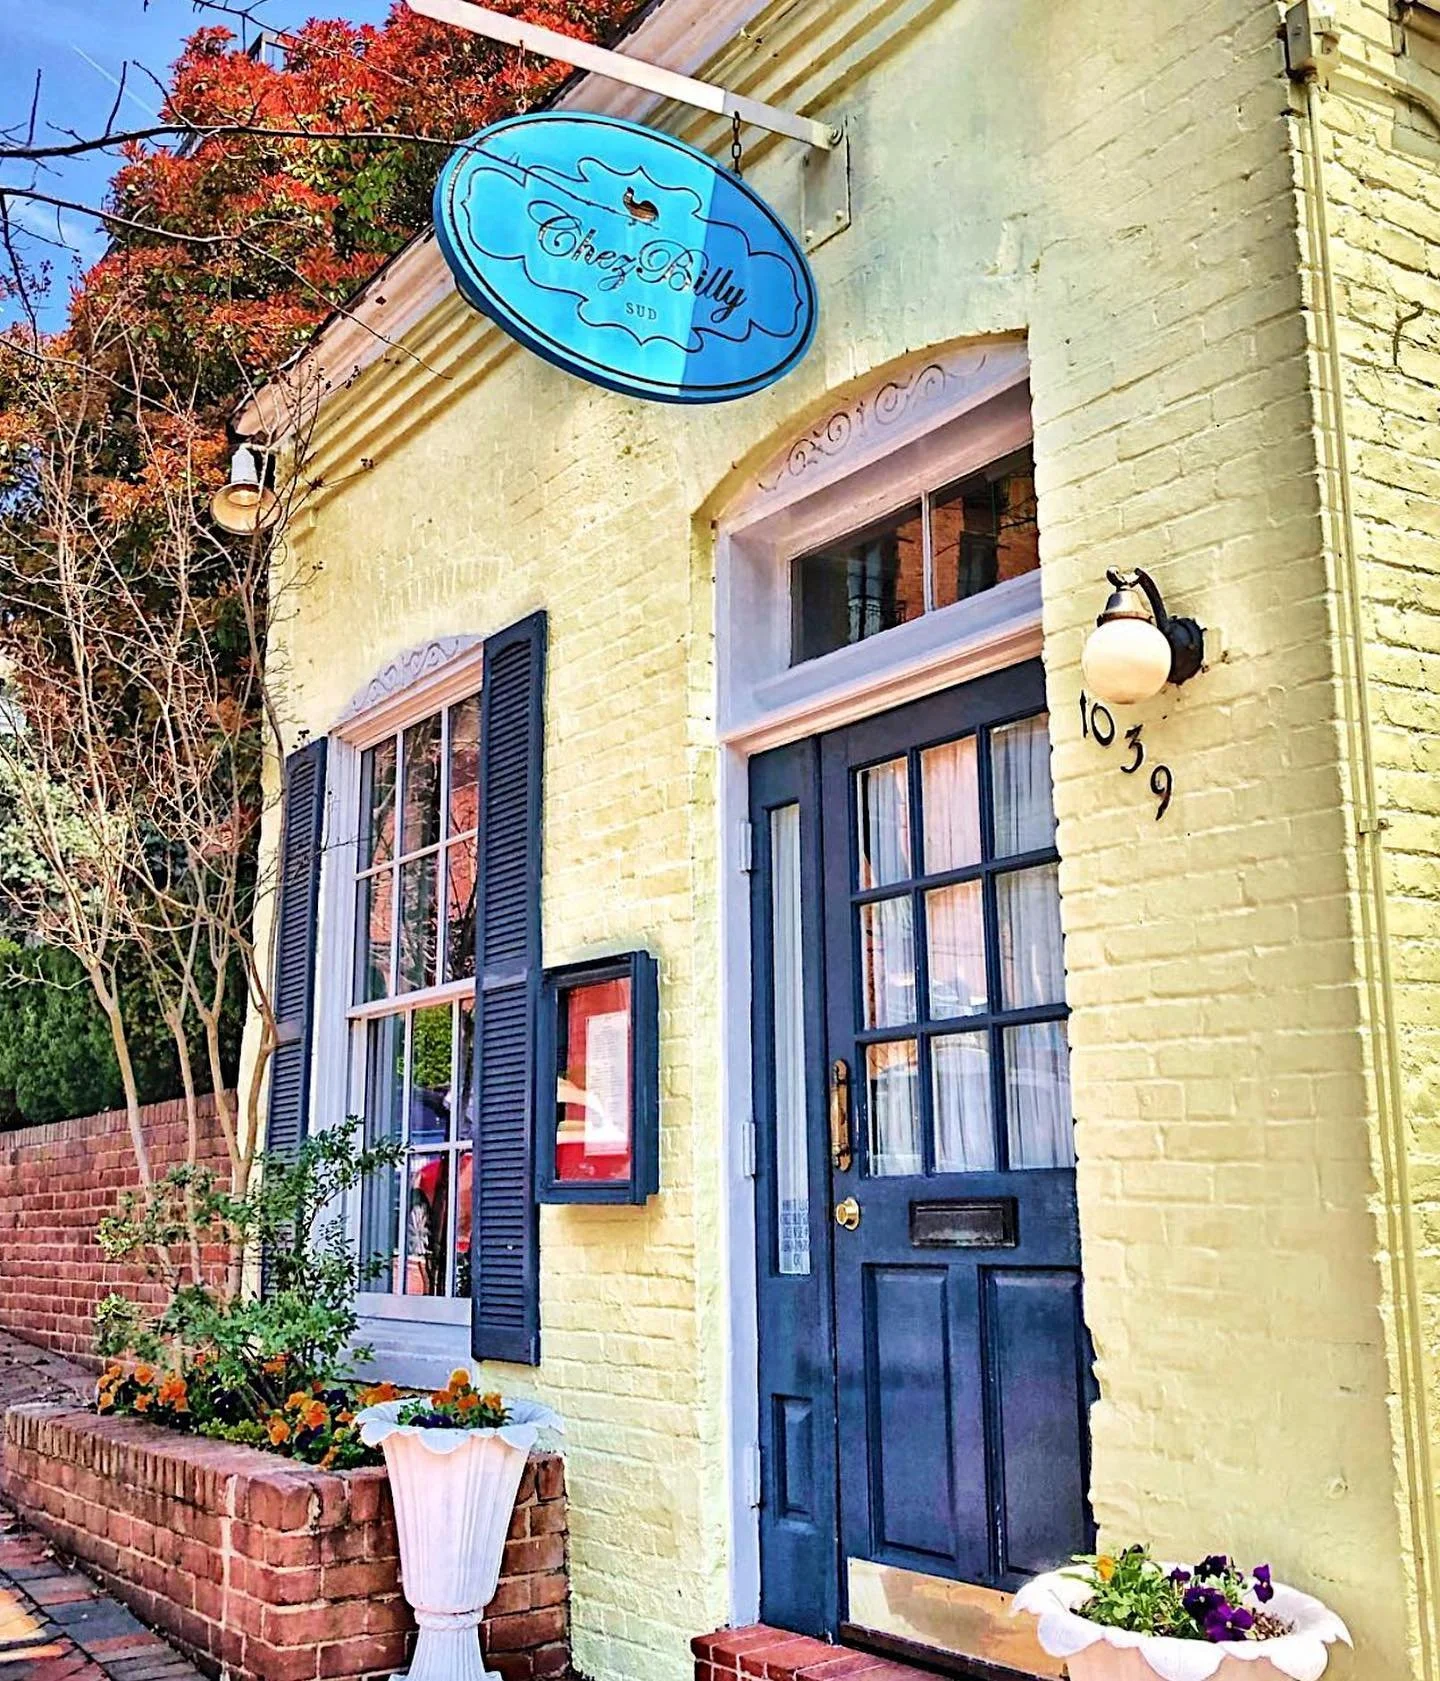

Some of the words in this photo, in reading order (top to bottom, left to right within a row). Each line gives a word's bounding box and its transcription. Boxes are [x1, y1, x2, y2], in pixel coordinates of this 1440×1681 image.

[527, 201, 635, 291] Chez
[636, 240, 747, 323] Billy
[625, 302, 657, 320] SUD
[1079, 690, 1172, 821] 1039
